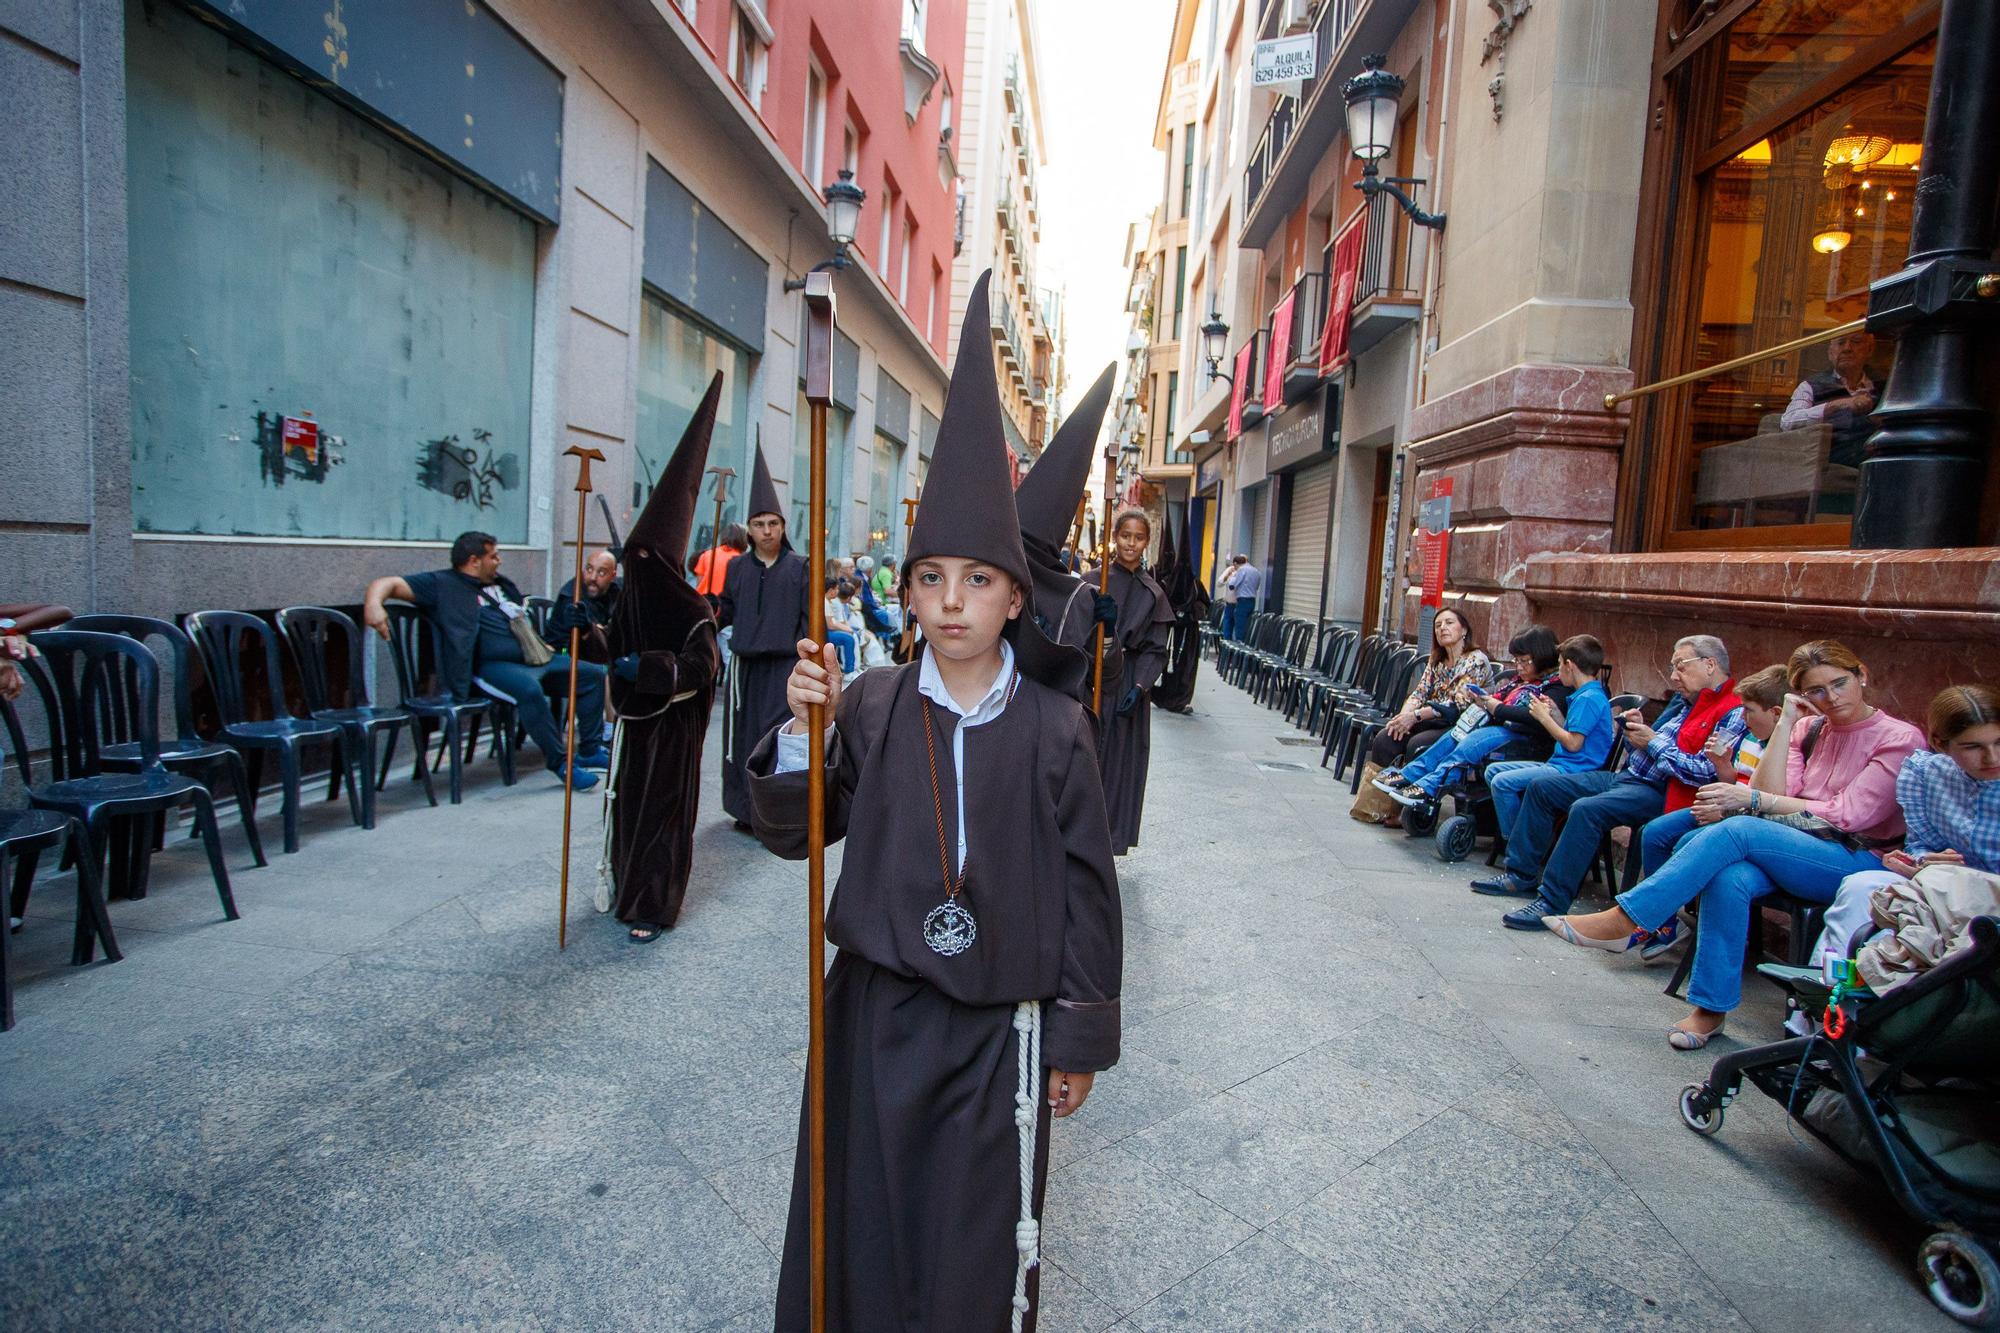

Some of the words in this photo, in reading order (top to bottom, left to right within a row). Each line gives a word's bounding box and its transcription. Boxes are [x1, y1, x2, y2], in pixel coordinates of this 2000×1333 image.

[1275, 49, 1311, 66] ALQUILA
[1255, 68, 1274, 82] 629
[1275, 66, 1293, 80] 459
[1295, 63, 1312, 77] 353
